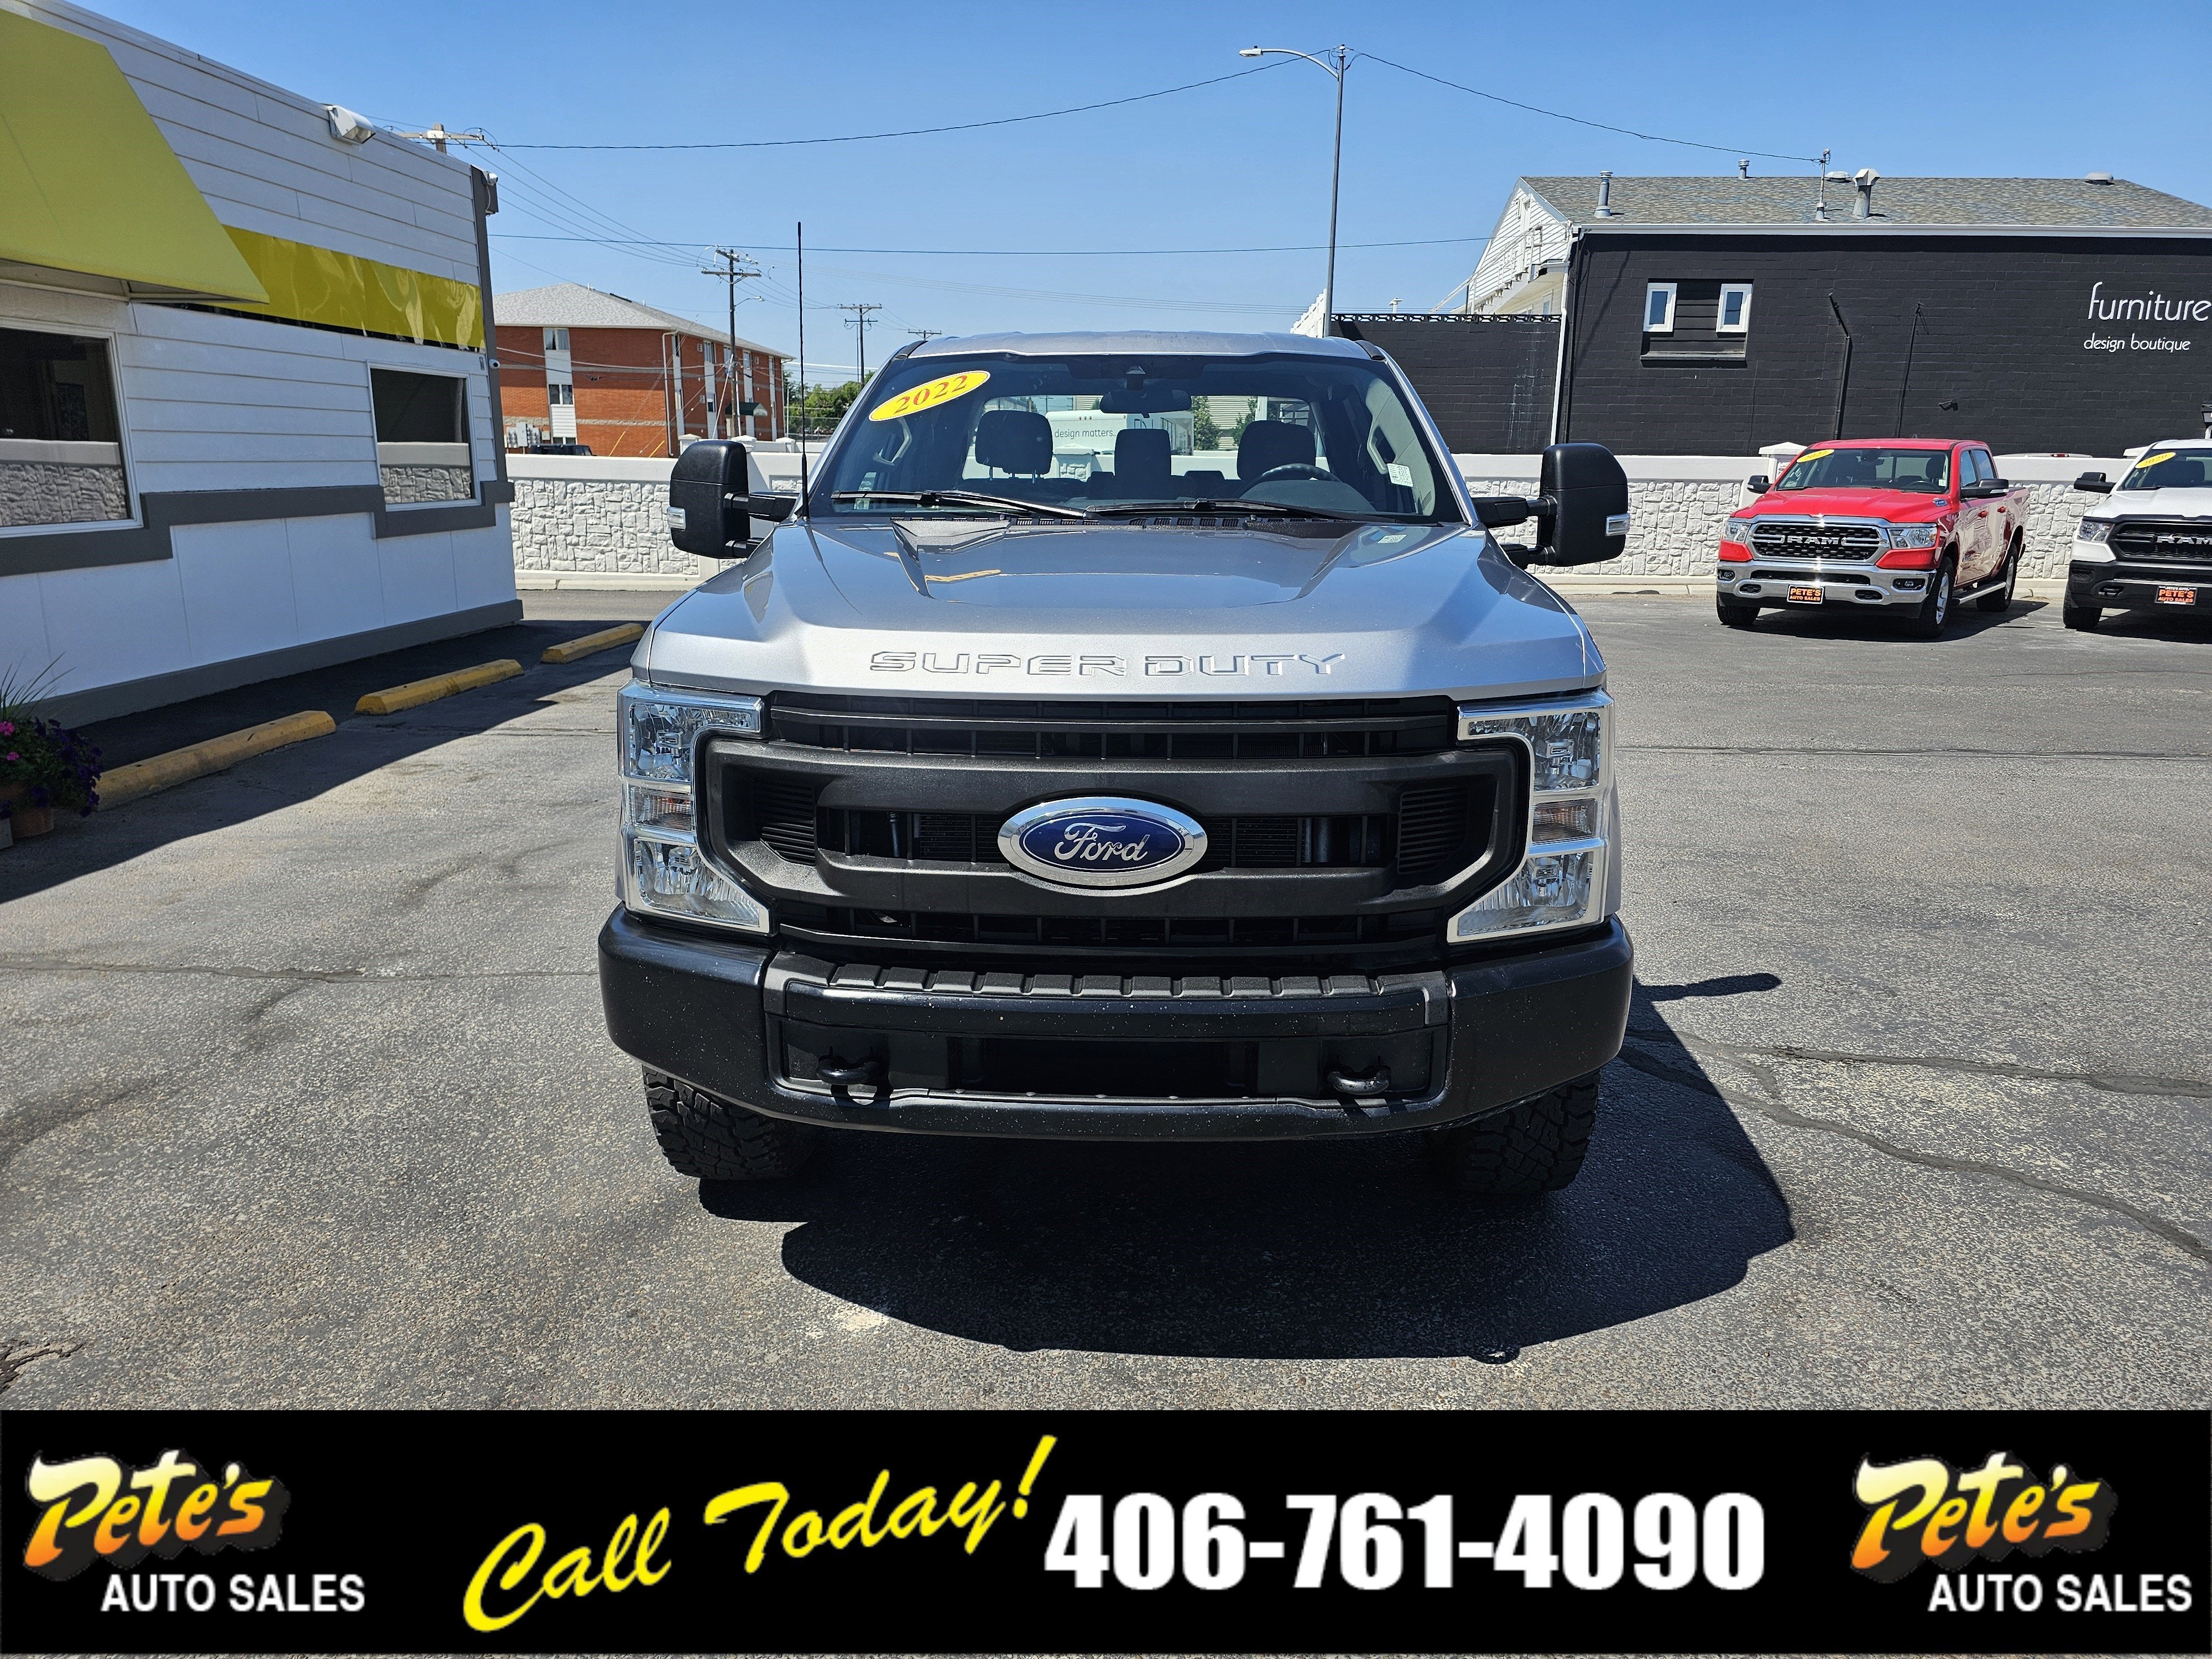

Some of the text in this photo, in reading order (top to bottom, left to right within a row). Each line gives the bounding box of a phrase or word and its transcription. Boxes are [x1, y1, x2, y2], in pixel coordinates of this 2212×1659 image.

[2088, 281, 2212, 321] furniture
[2083, 332, 2191, 353] design boutique
[893, 375, 968, 415] 2022
[1054, 429, 1079, 440] design
[1787, 535, 1839, 545] RAM
[2157, 535, 2212, 545] RAM
[1790, 588, 1821, 597] PETE'S
[2158, 589, 2194, 598] PETE'S
[870, 651, 1345, 677] SUPER DUTY
[1054, 822, 1151, 861] Ford
